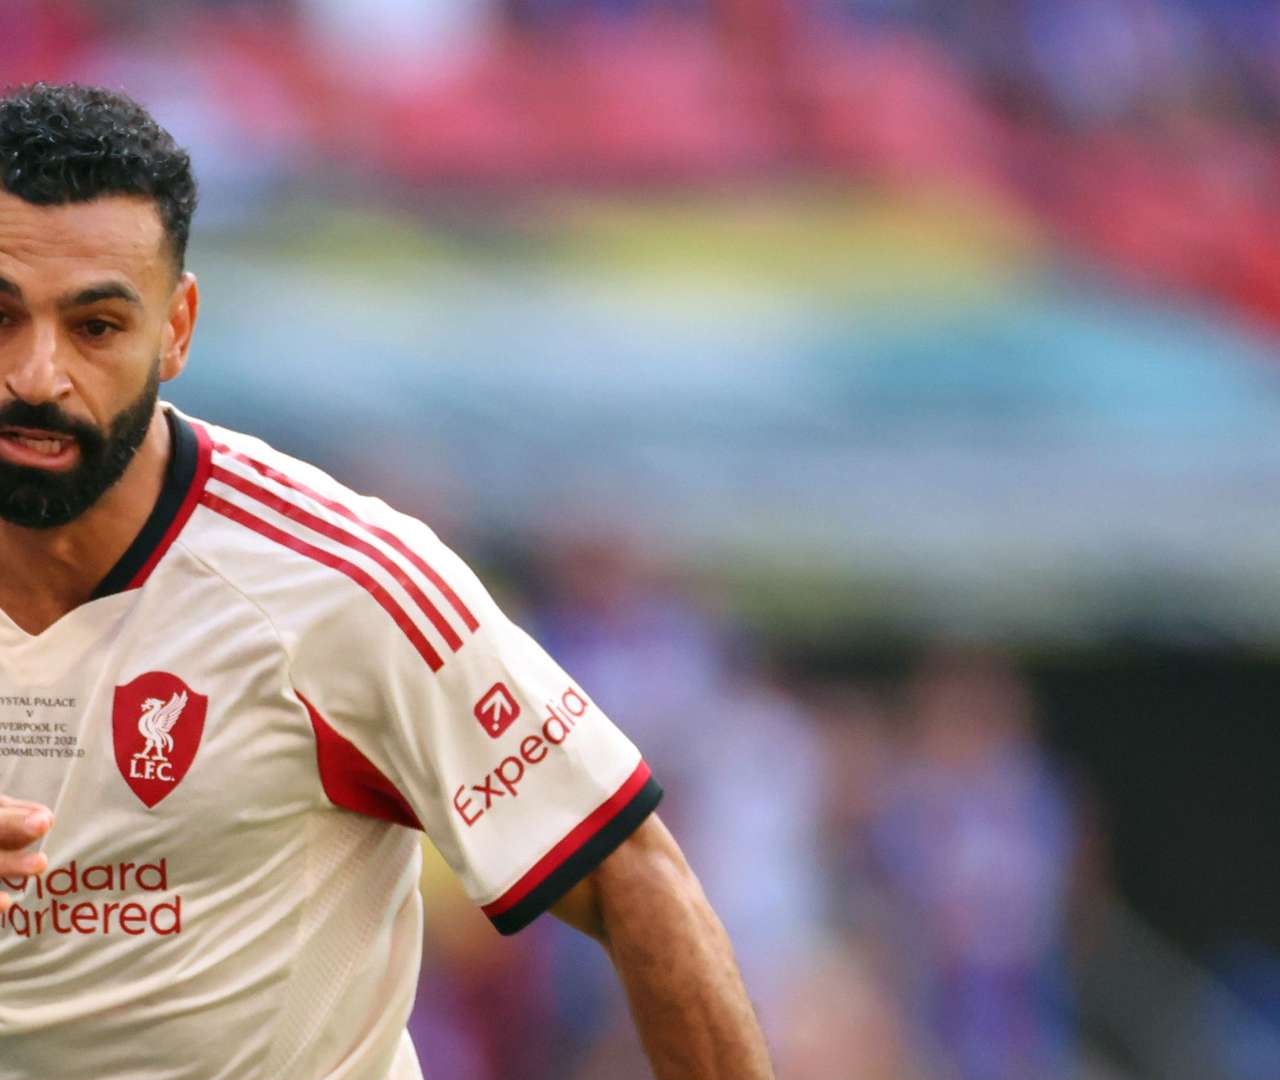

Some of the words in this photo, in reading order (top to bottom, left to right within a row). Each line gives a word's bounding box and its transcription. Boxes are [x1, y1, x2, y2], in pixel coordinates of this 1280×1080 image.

[34, 697, 77, 708] PALACE
[54, 723, 67, 733] FC
[9, 734, 51, 745] AUGUST
[453, 686, 589, 827] Expedia
